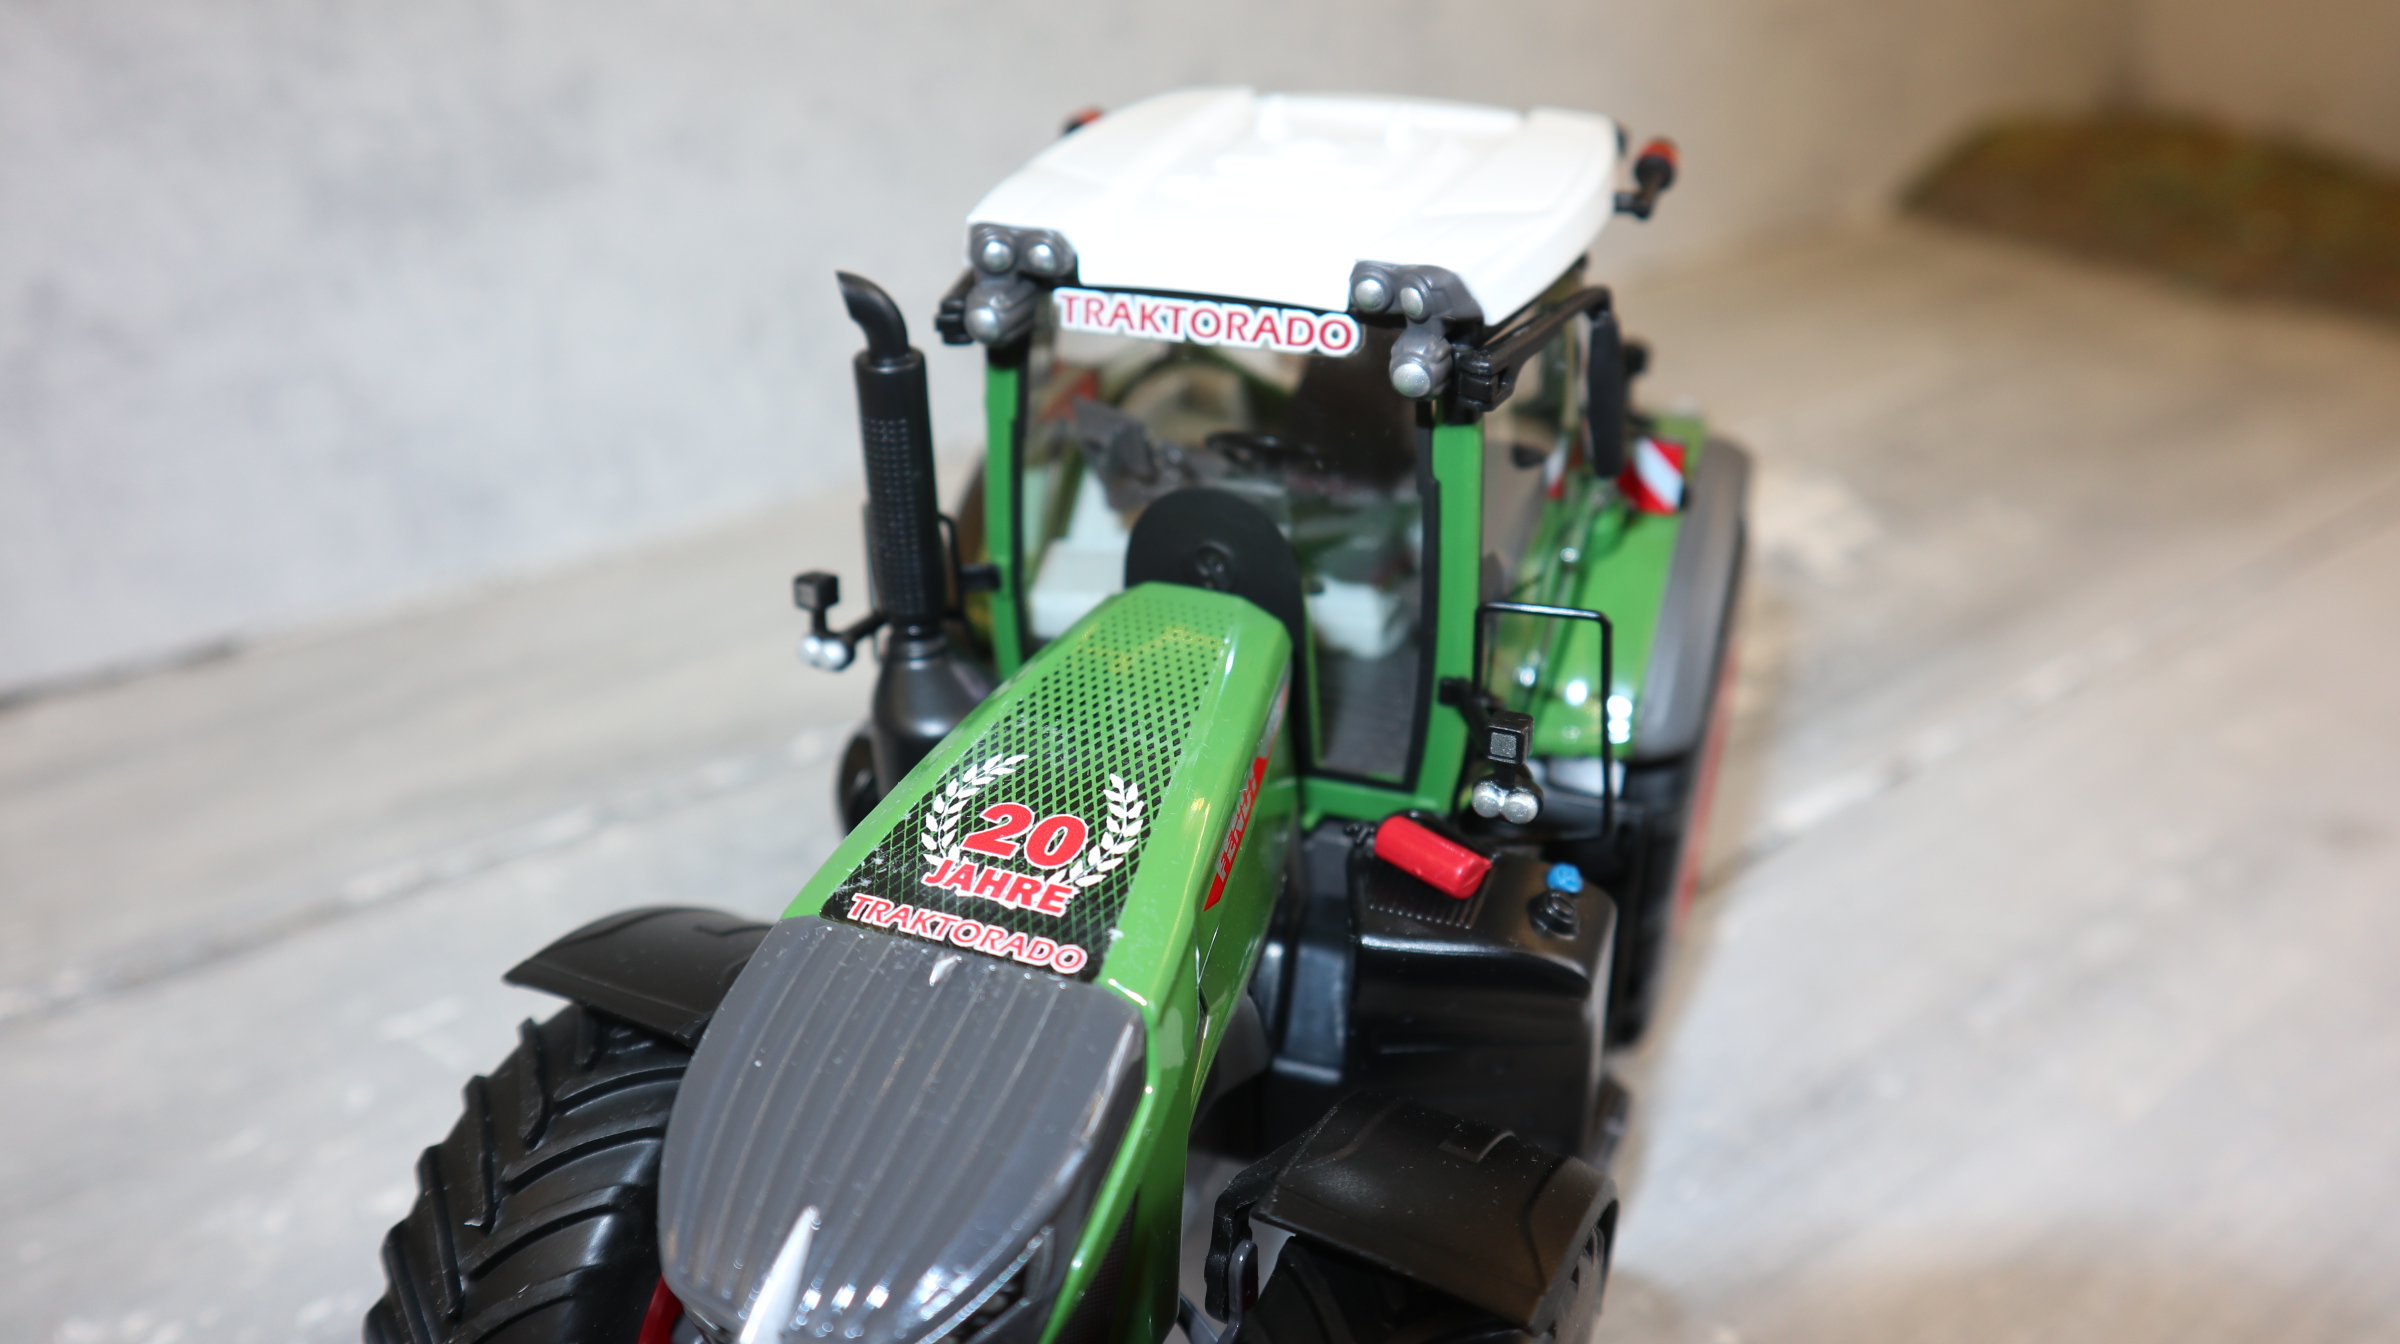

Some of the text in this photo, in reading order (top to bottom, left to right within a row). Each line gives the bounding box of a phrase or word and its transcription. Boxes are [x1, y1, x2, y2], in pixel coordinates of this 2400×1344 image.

[1058, 293, 1354, 352] TRAKTORADO
[963, 803, 1088, 868] 20
[923, 858, 1076, 915] JAHRE
[849, 894, 1087, 973] TRAKTORADO
